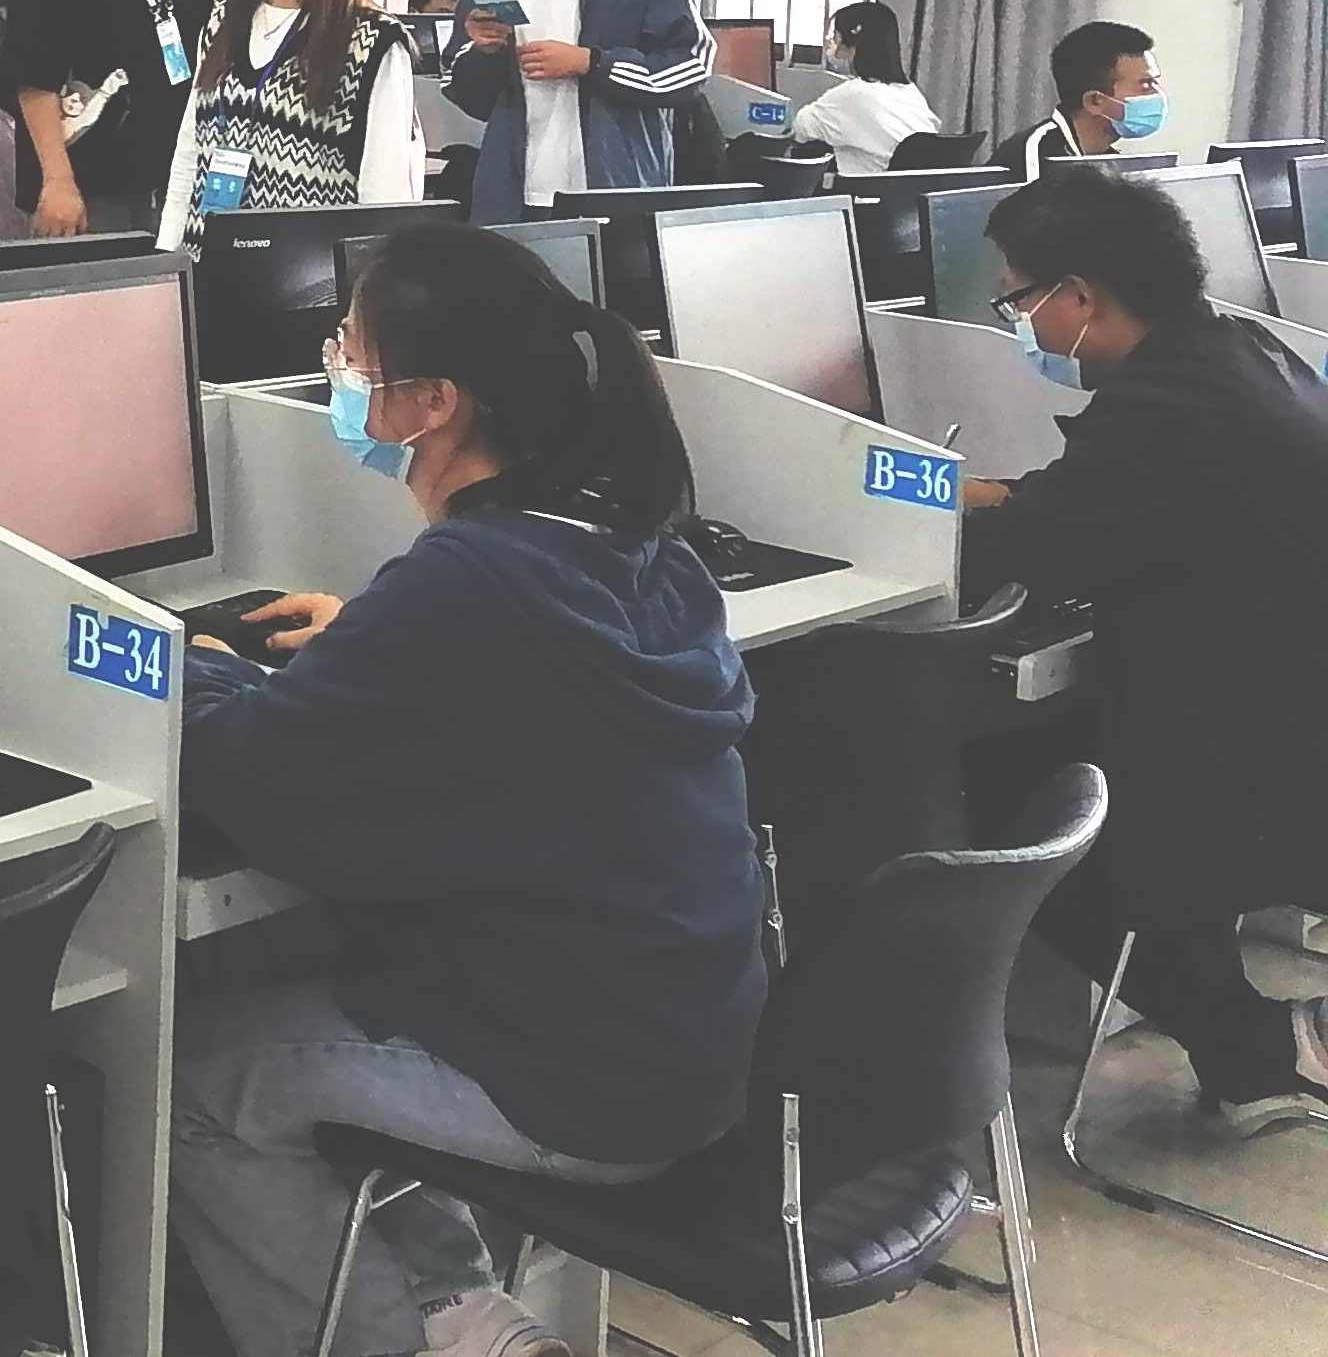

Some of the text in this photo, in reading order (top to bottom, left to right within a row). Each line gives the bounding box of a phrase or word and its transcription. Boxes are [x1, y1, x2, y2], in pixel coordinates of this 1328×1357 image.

[233, 237, 271, 248] lenovo
[870, 451, 951, 503] B-36
[73, 613, 163, 690] B-34
